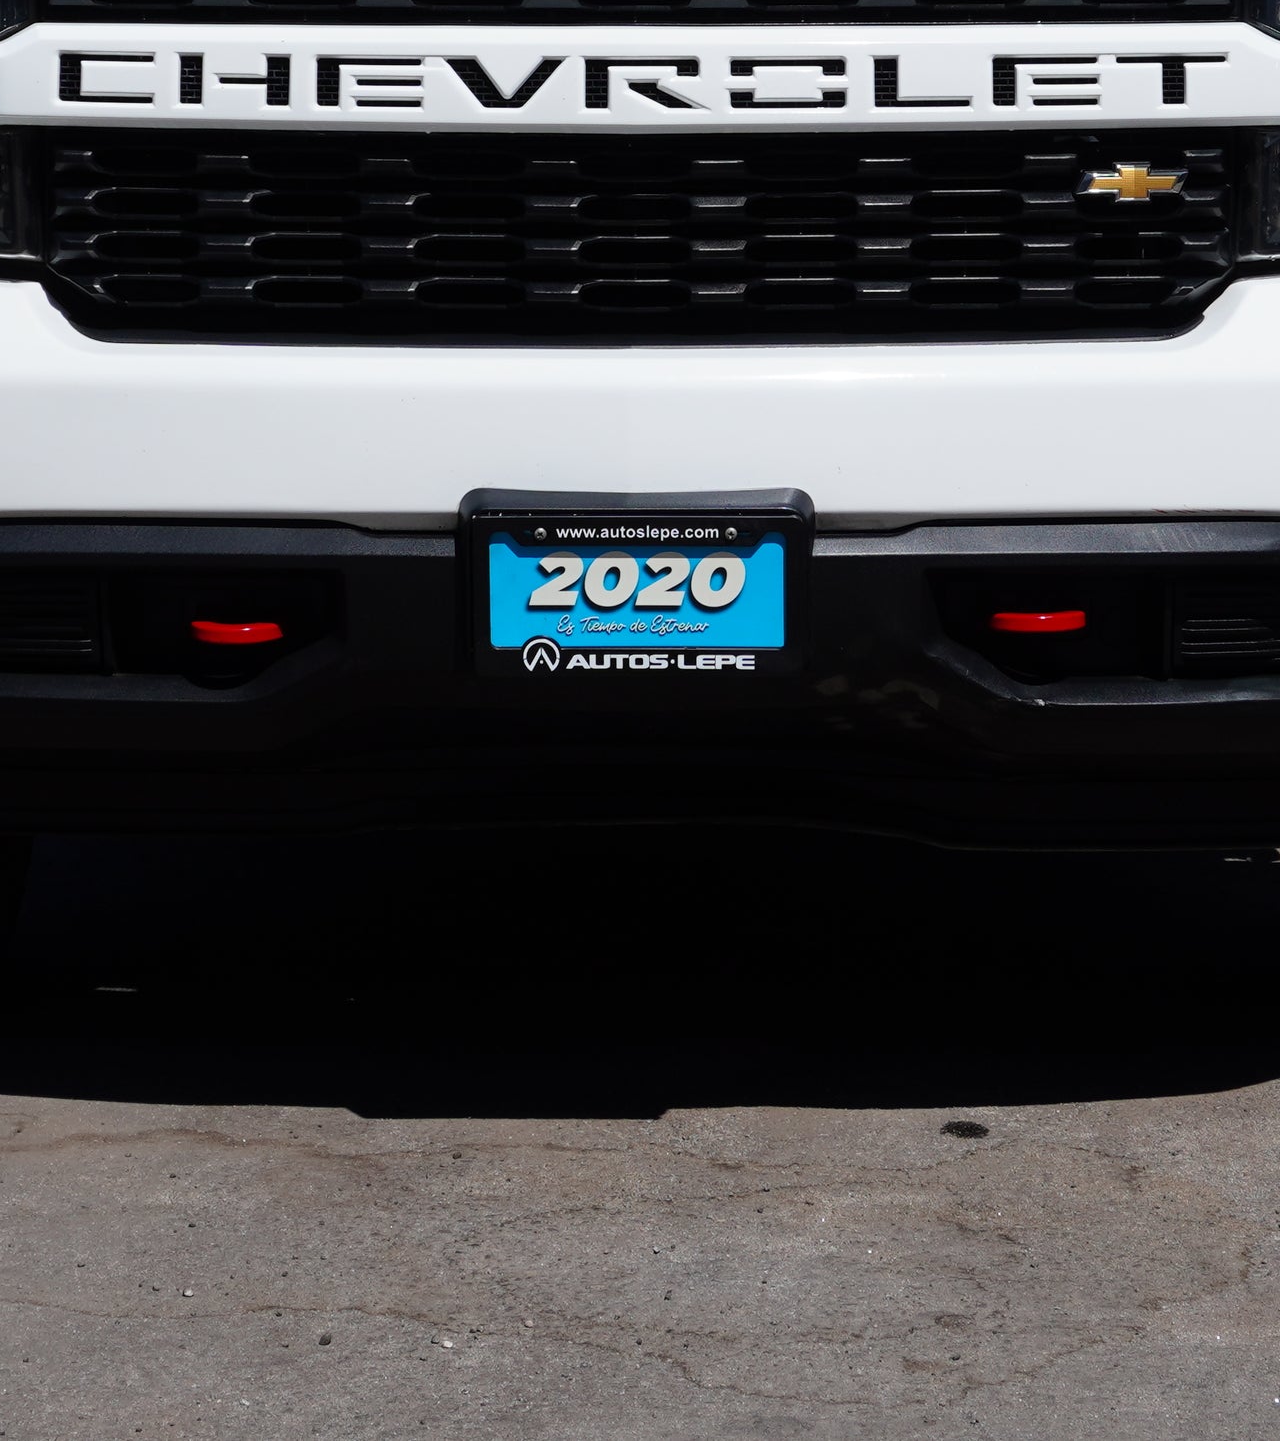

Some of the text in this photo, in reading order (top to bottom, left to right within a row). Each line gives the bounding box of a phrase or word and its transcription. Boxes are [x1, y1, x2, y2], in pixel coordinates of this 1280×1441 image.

[57, 51, 1231, 111] CHEVROLET
[555, 525, 720, 542] www.autoslepe.com
[528, 551, 746, 608] 2020
[556, 614, 710, 636] Es Tiempo de Estrenar
